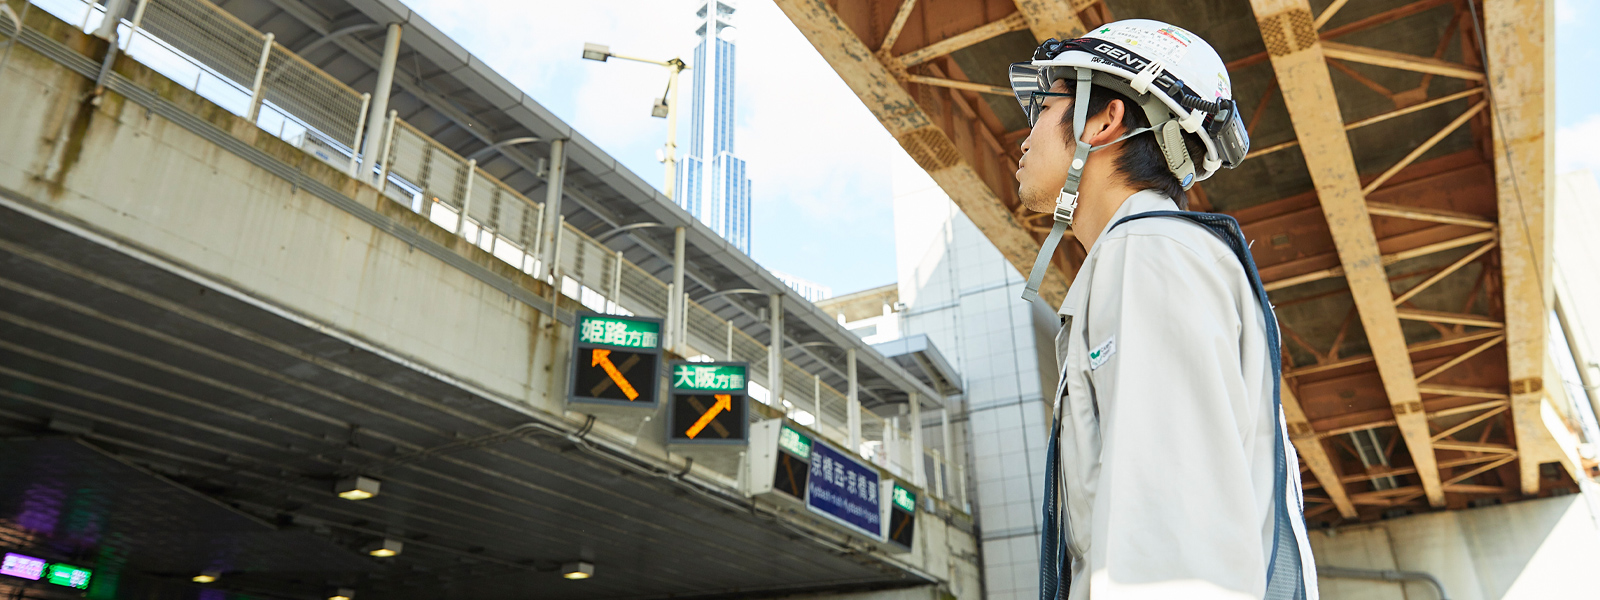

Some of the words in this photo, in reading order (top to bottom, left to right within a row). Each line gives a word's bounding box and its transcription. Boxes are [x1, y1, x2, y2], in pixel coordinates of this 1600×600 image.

[1094, 43, 1176, 88] GENTS
[580, 318, 659, 349] 姫路方面
[673, 365, 744, 390] 大阪方面
